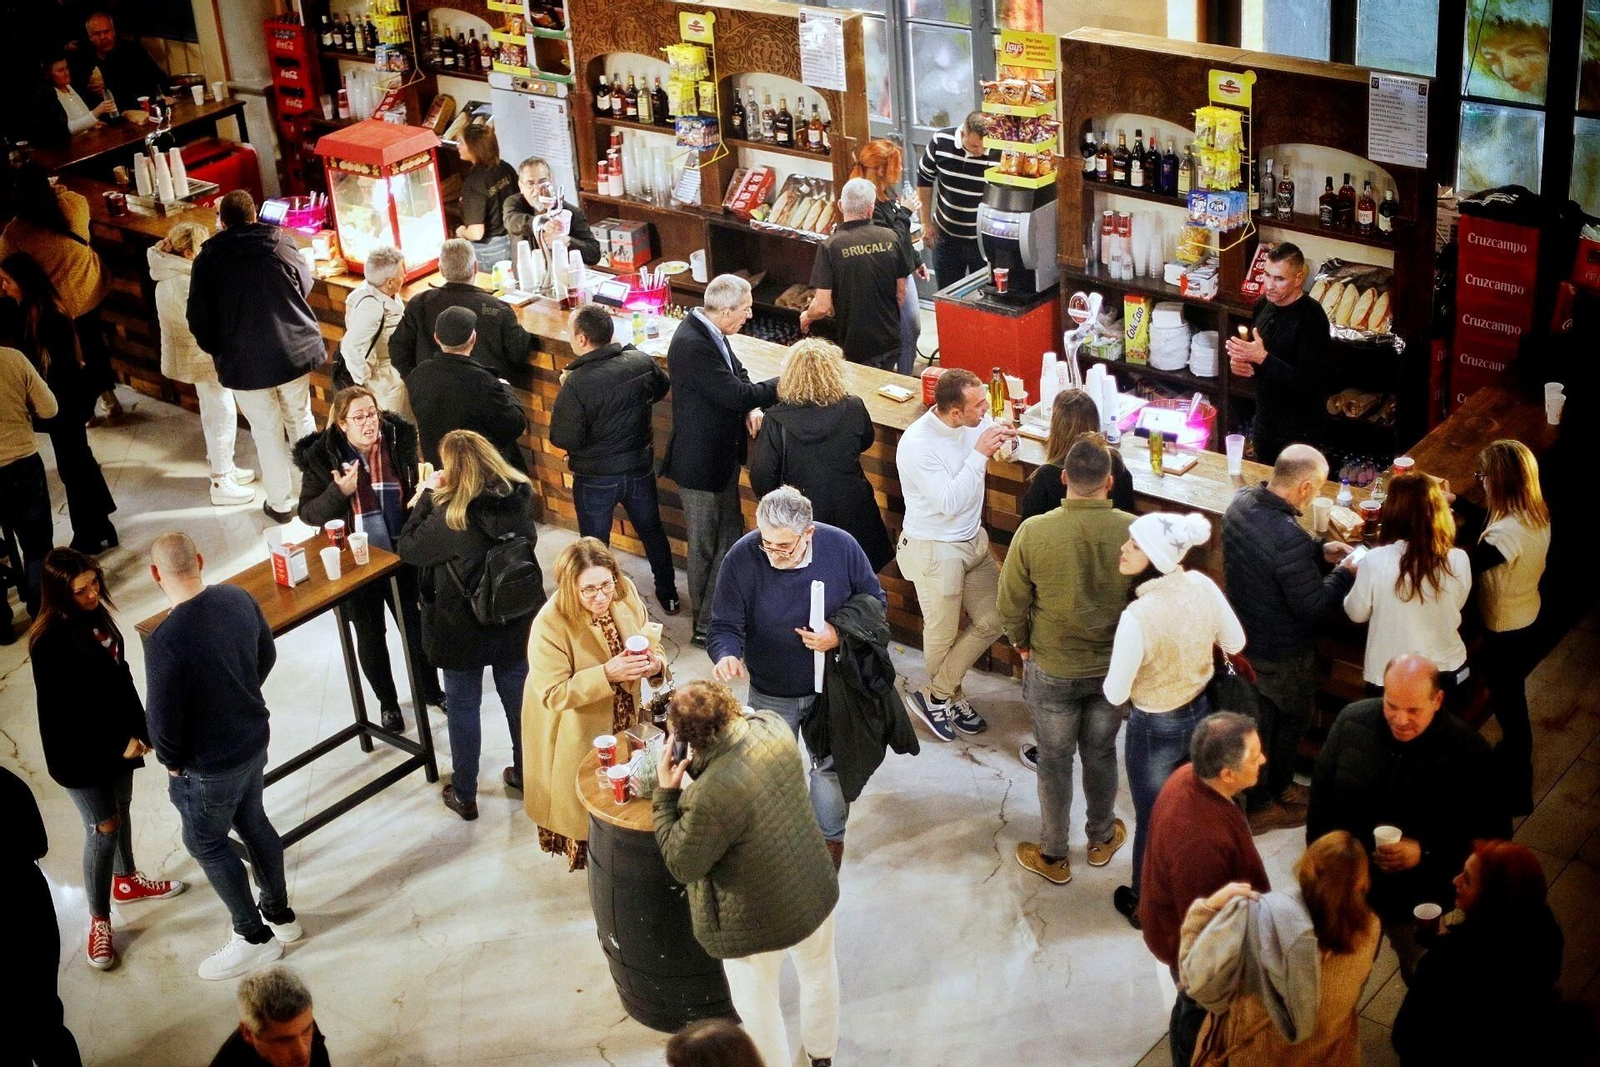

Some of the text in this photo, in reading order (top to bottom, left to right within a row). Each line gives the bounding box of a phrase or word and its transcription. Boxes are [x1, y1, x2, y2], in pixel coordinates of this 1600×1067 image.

[841, 242, 887, 259] BRUGAL
[1467, 232, 1528, 254] Cruzcampo
[1465, 273, 1525, 295] Cruzcampo
[1462, 313, 1522, 335] Cruzcampo
